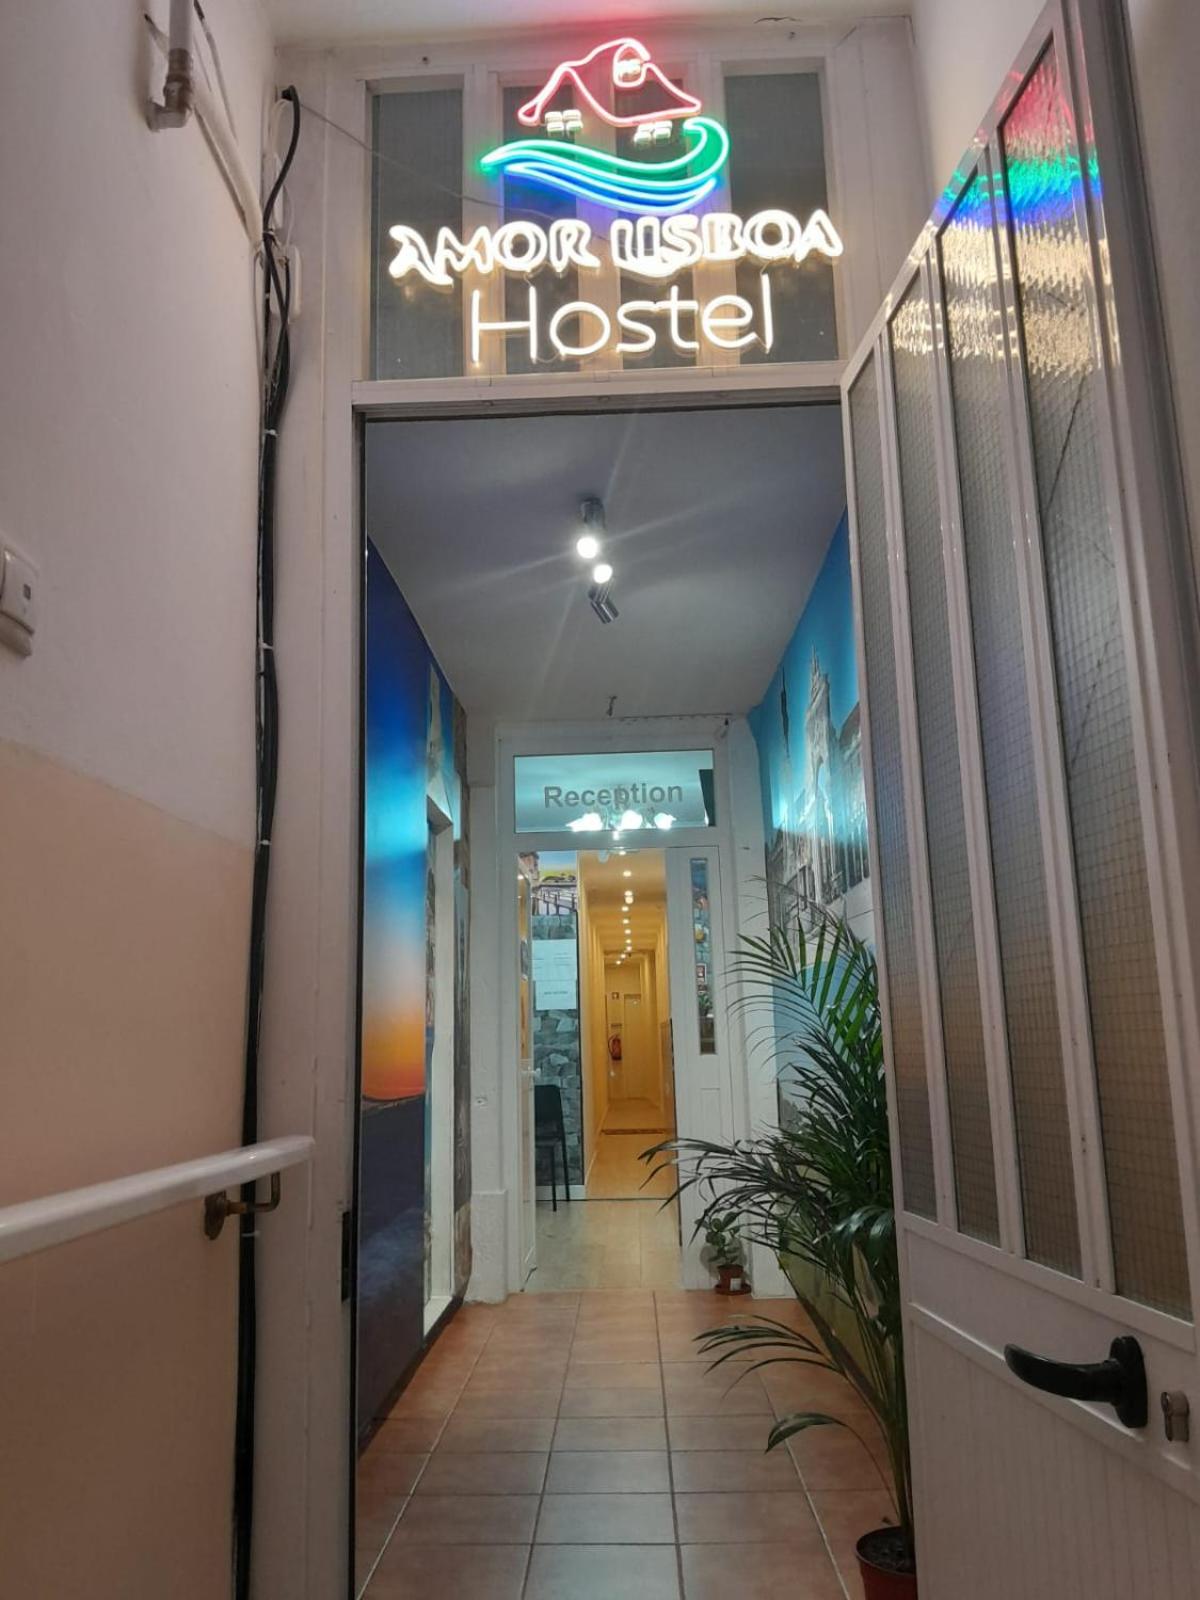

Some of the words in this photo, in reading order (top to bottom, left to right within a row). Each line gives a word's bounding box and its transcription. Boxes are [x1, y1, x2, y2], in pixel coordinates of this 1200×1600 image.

[388, 219, 600, 285] AMOR
[610, 209, 845, 279] LISBOA
[471, 273, 775, 363] Hostel
[543, 782, 684, 809] Reception
